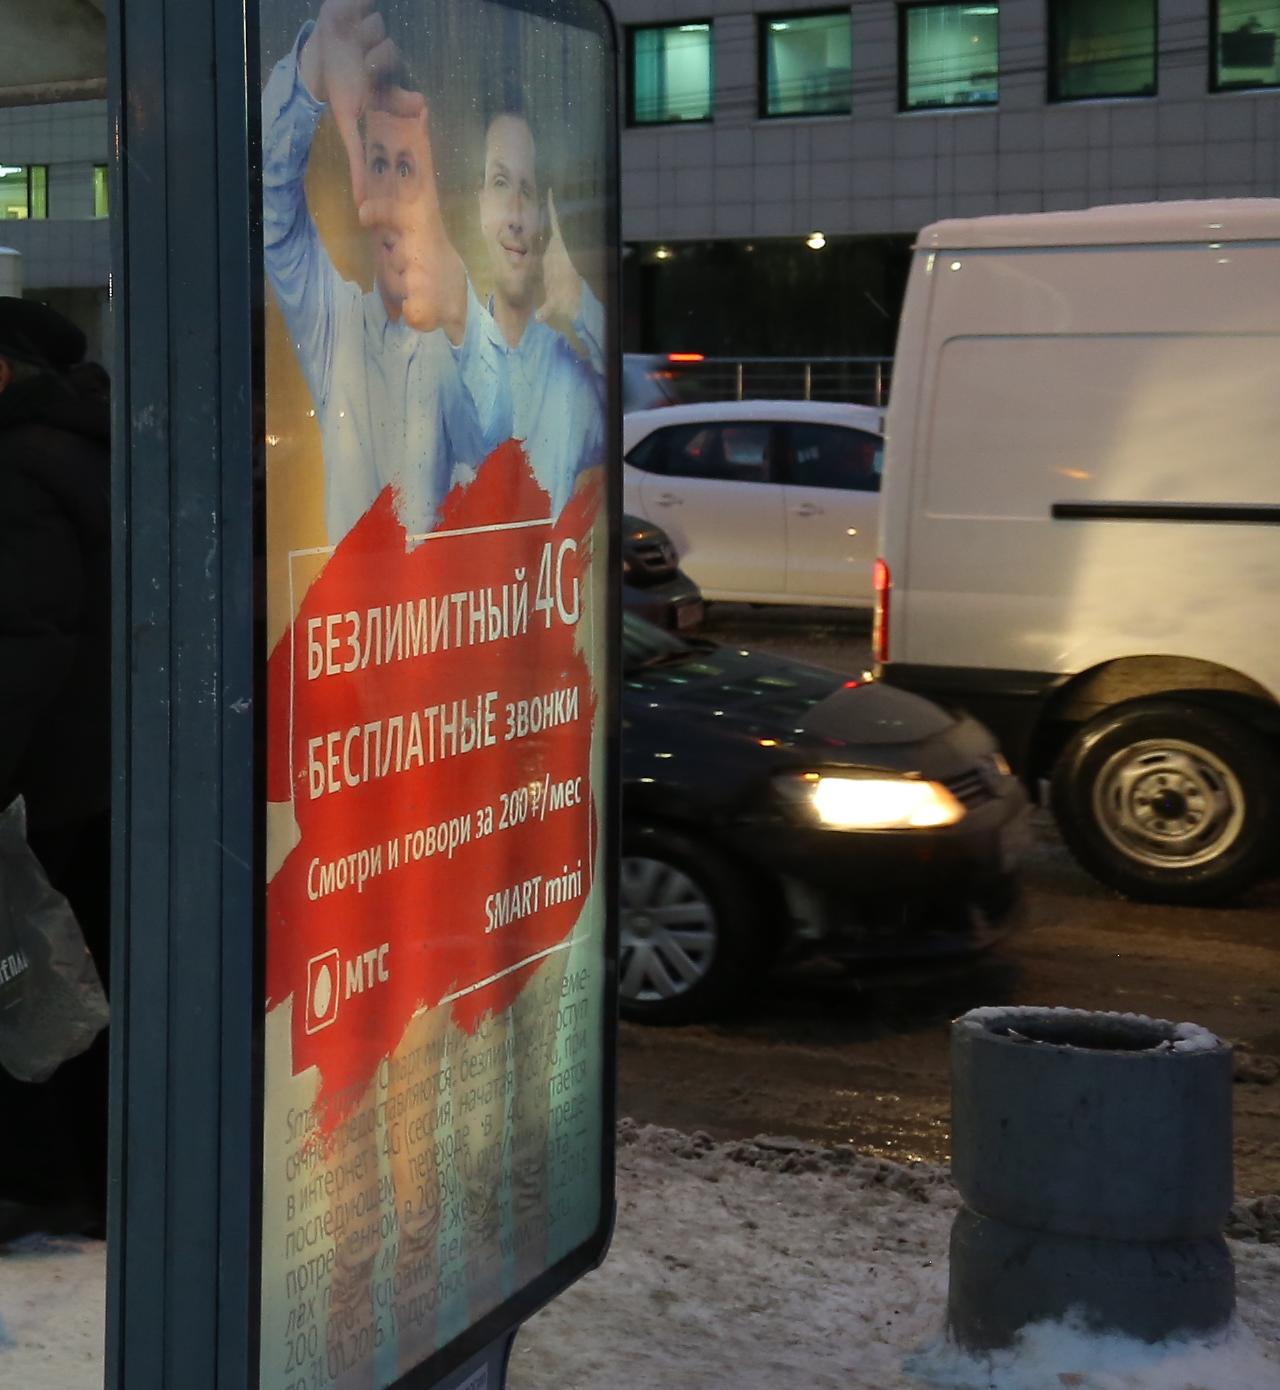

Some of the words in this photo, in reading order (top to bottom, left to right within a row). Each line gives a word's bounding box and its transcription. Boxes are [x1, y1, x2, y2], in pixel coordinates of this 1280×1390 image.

[307, 567, 527, 681] БЕЗЛИМИТНЫЙ
[535, 537, 580, 629] 4G
[308, 691, 499, 799] БЕСПЛАТНЫЕ
[307, 848, 382, 901] Смотри
[388, 838, 399, 869] и
[404, 815, 471, 864] говори
[475, 804, 494, 840] за
[484, 874, 542, 934] SMART
[544, 859, 582, 908] mini
